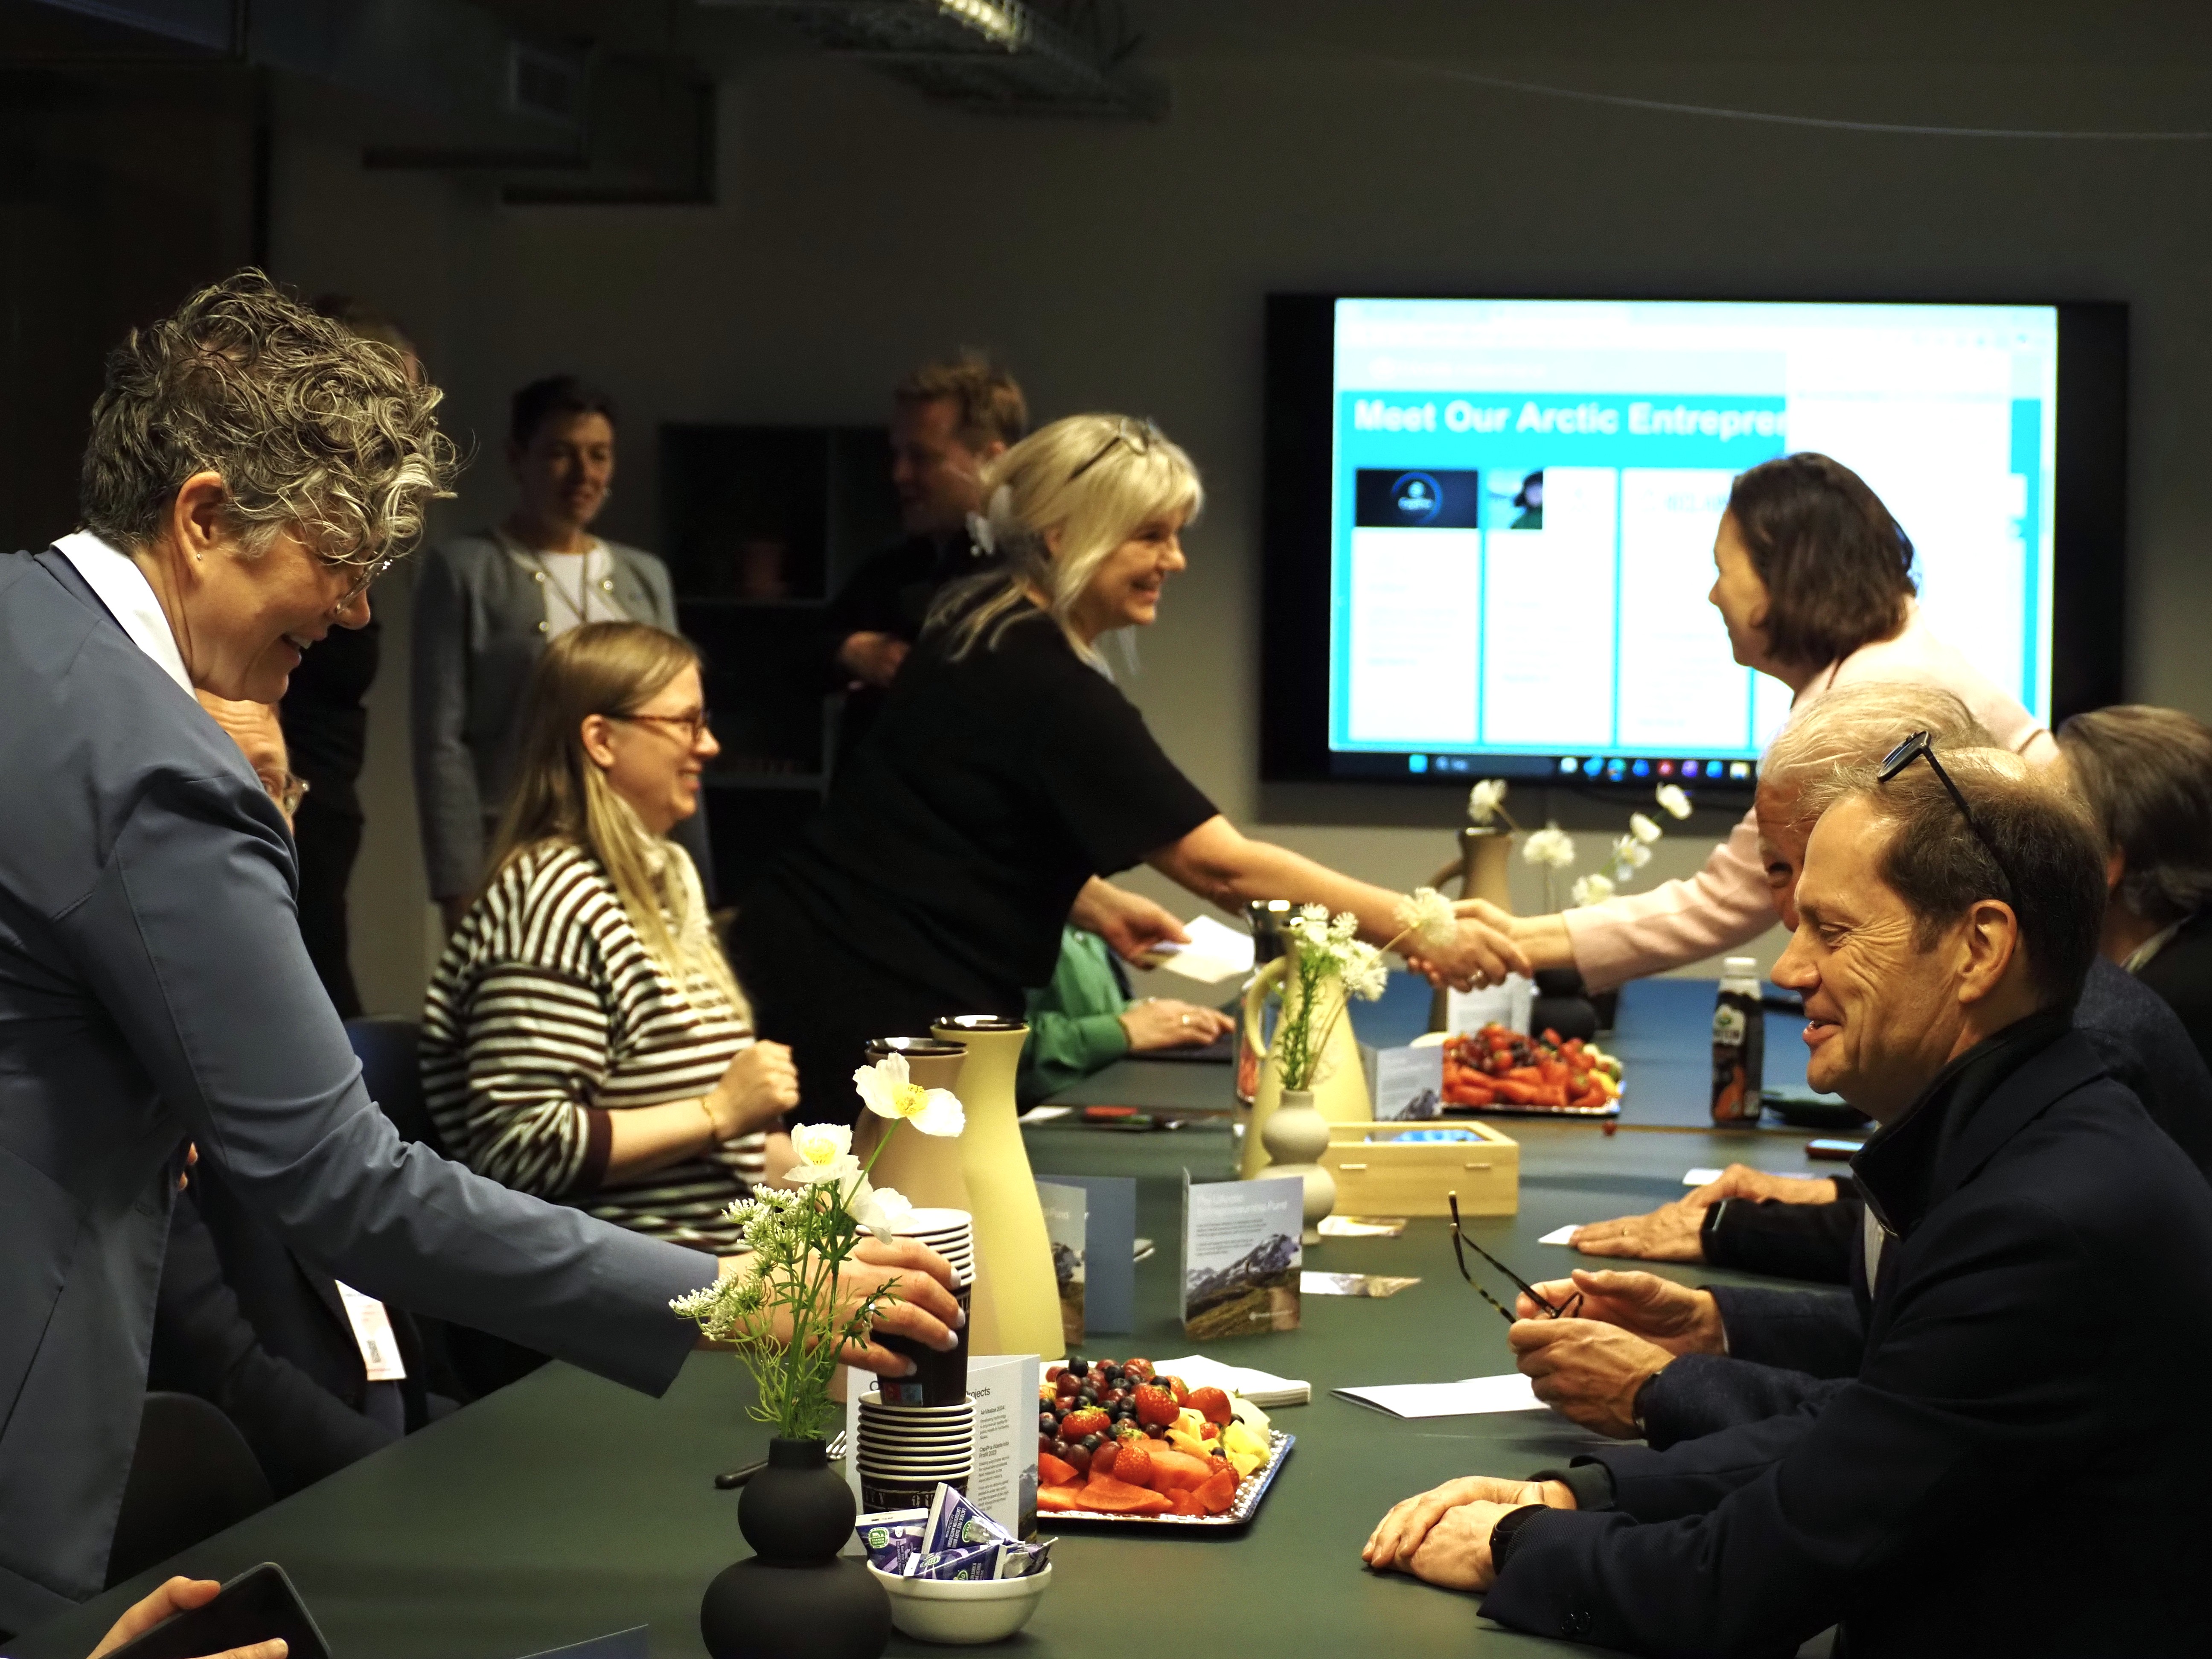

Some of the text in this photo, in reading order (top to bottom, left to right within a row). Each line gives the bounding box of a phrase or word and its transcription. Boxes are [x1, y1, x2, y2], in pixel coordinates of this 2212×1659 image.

[1354, 399, 1436, 432] Meet
[1444, 400, 1511, 433] Our
[1516, 402, 1618, 434] Arctic
